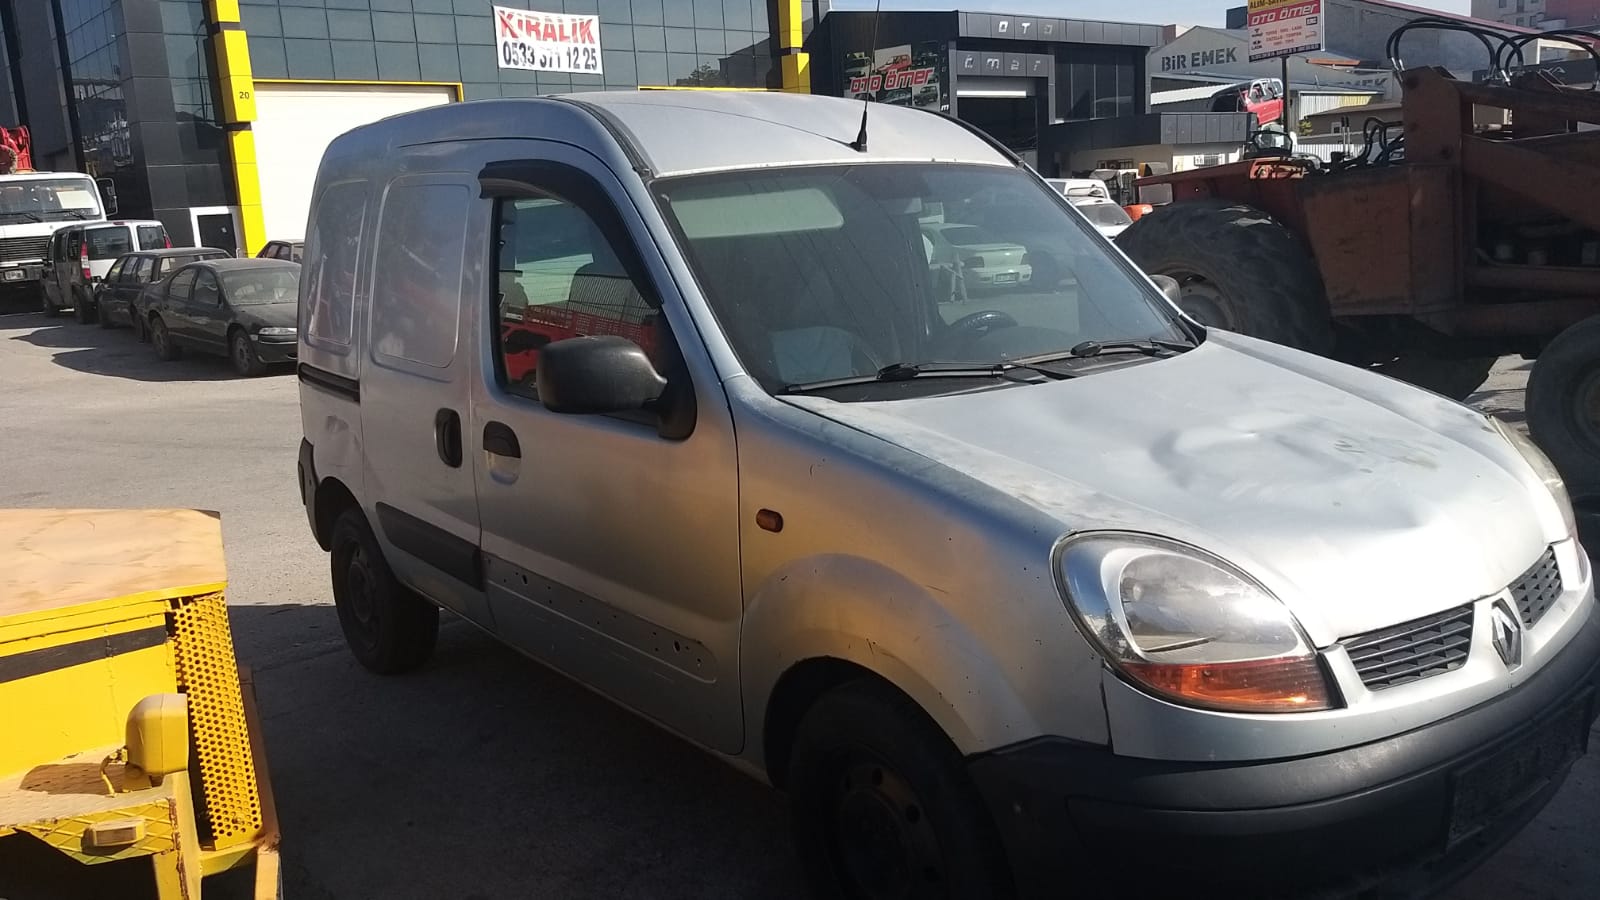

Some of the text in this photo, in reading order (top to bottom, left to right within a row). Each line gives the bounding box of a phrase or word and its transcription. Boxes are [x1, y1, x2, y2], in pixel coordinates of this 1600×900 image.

[1251, 12, 1276, 25] OTO
[503, 41, 535, 66] 0533
[567, 47, 580, 69] 12
[582, 47, 597, 70] 25
[1191, 46, 1238, 67] EMEK
[239, 91, 250, 99] 20
